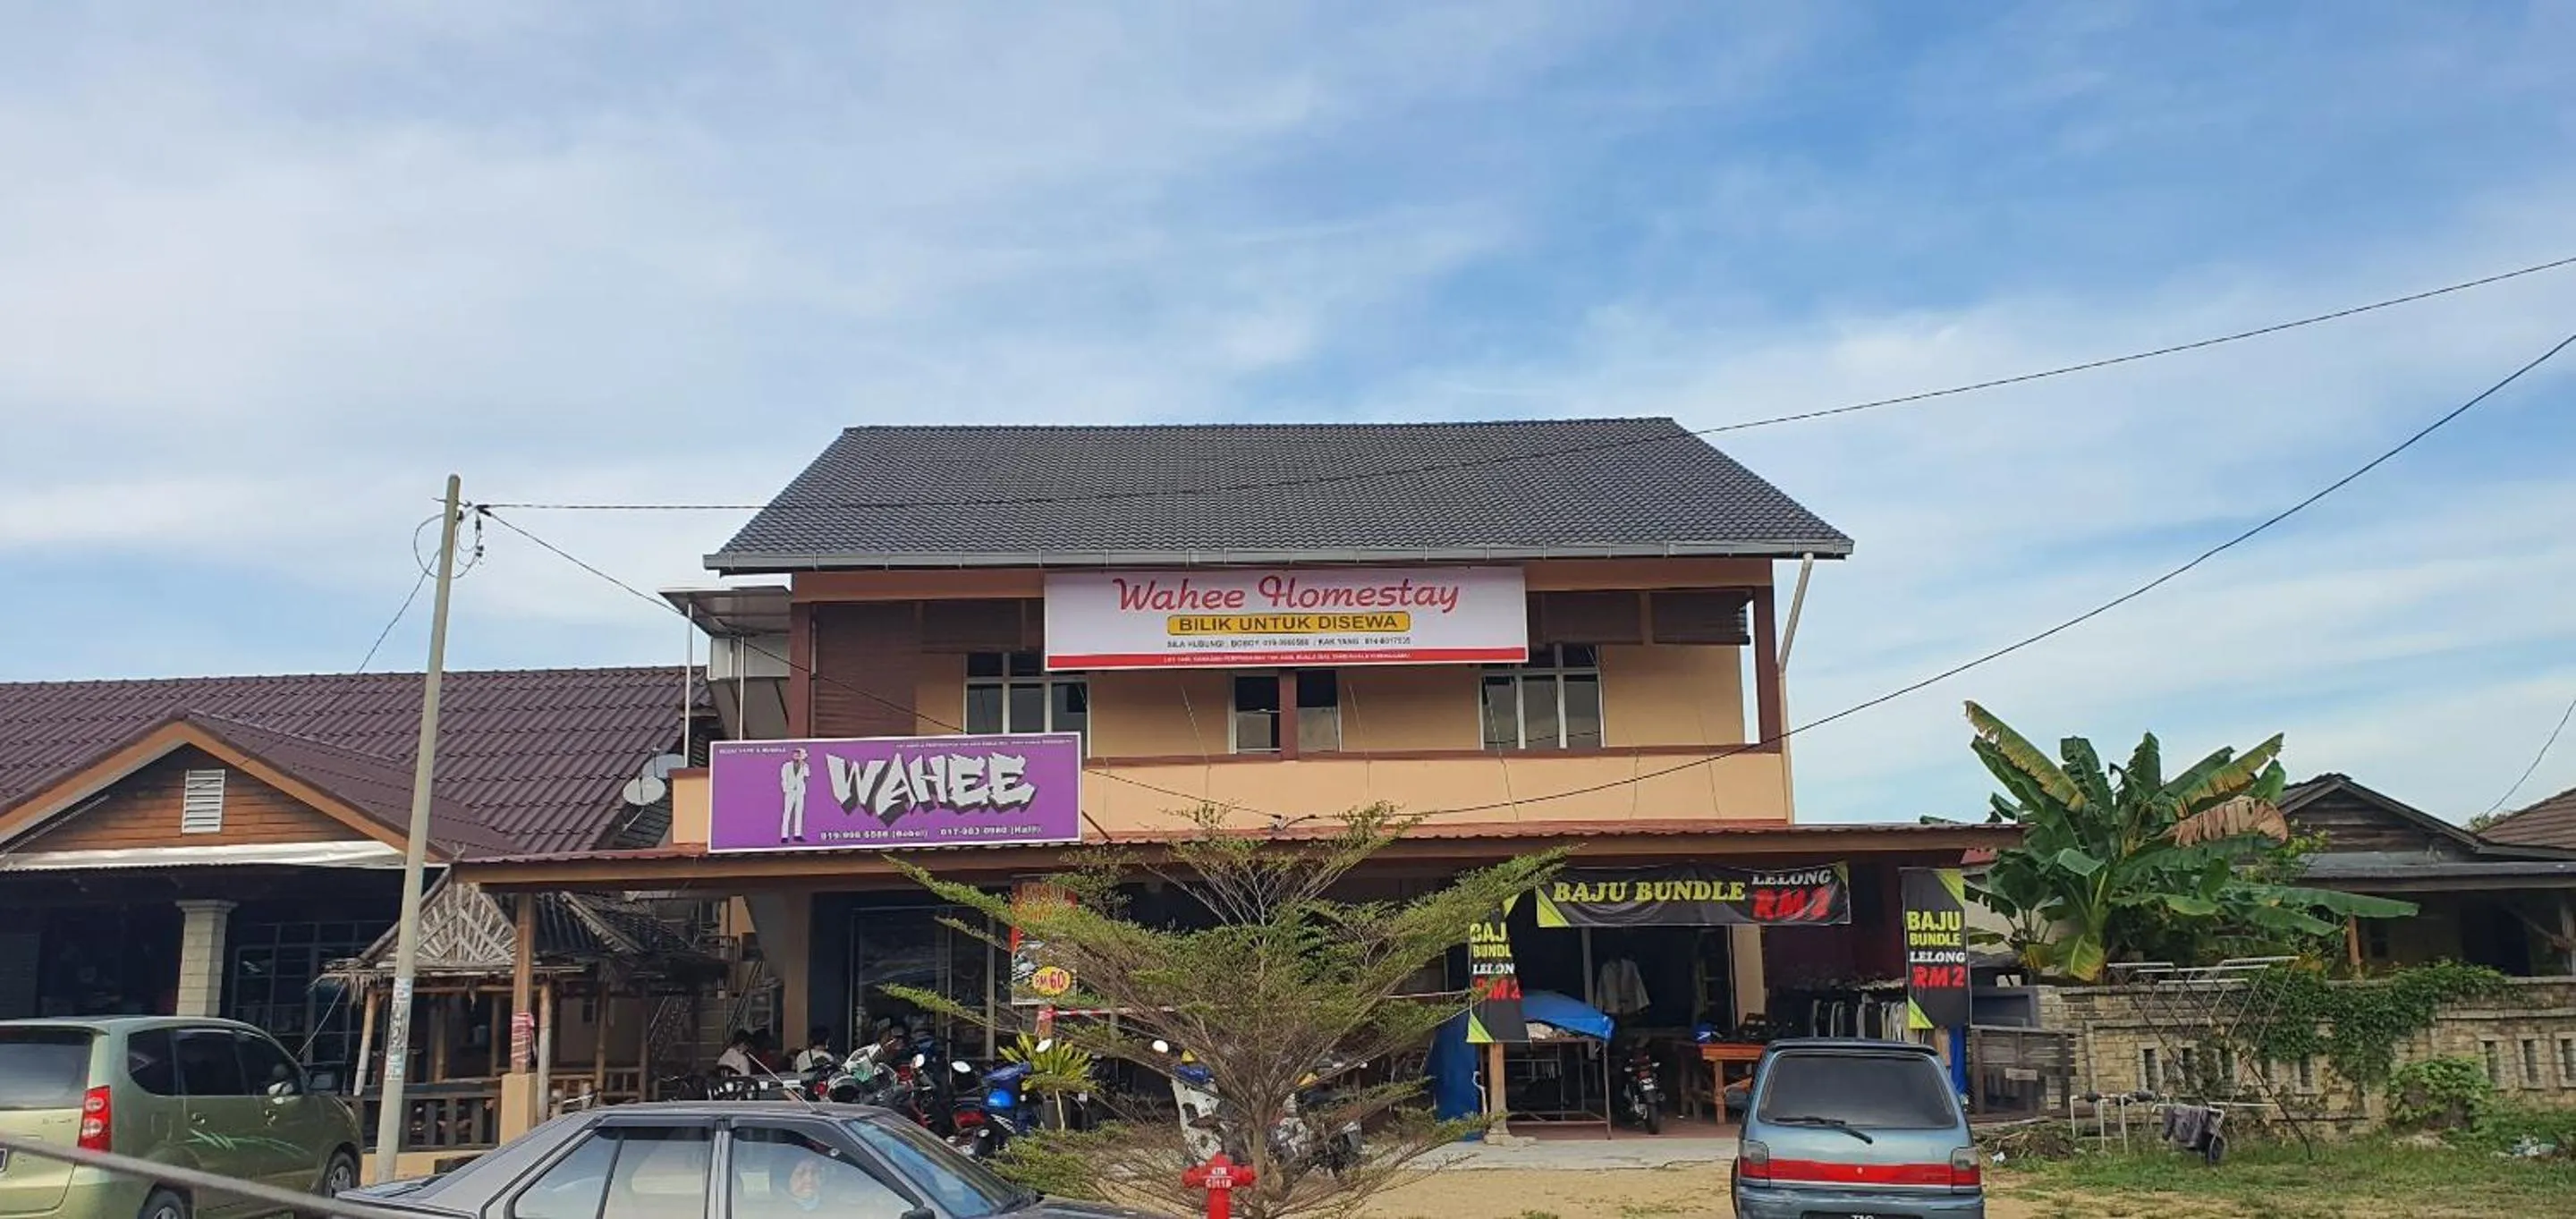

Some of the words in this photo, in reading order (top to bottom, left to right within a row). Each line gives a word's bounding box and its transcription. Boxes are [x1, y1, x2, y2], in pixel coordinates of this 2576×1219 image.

[1112, 577, 1247, 611] Wahee
[1258, 575, 1459, 614] Homestay
[1178, 617, 1233, 631] BILIK
[1239, 615, 1311, 631] UNTUK
[1318, 614, 1398, 630] DISEWA
[826, 752, 1038, 826] WAHEE
[1751, 868, 1832, 886] LELONG
[1552, 882, 1627, 903] BAJU
[1634, 881, 1747, 902] BUNDLE
[1906, 910, 1961, 931] BAJU
[1470, 921, 1508, 943] BAJ
[1909, 931, 1962, 947] BUNDLE
[1472, 943, 1513, 958] BUNDL
[1909, 950, 1966, 963] LELONG
[1472, 962, 1515, 975] LELON
